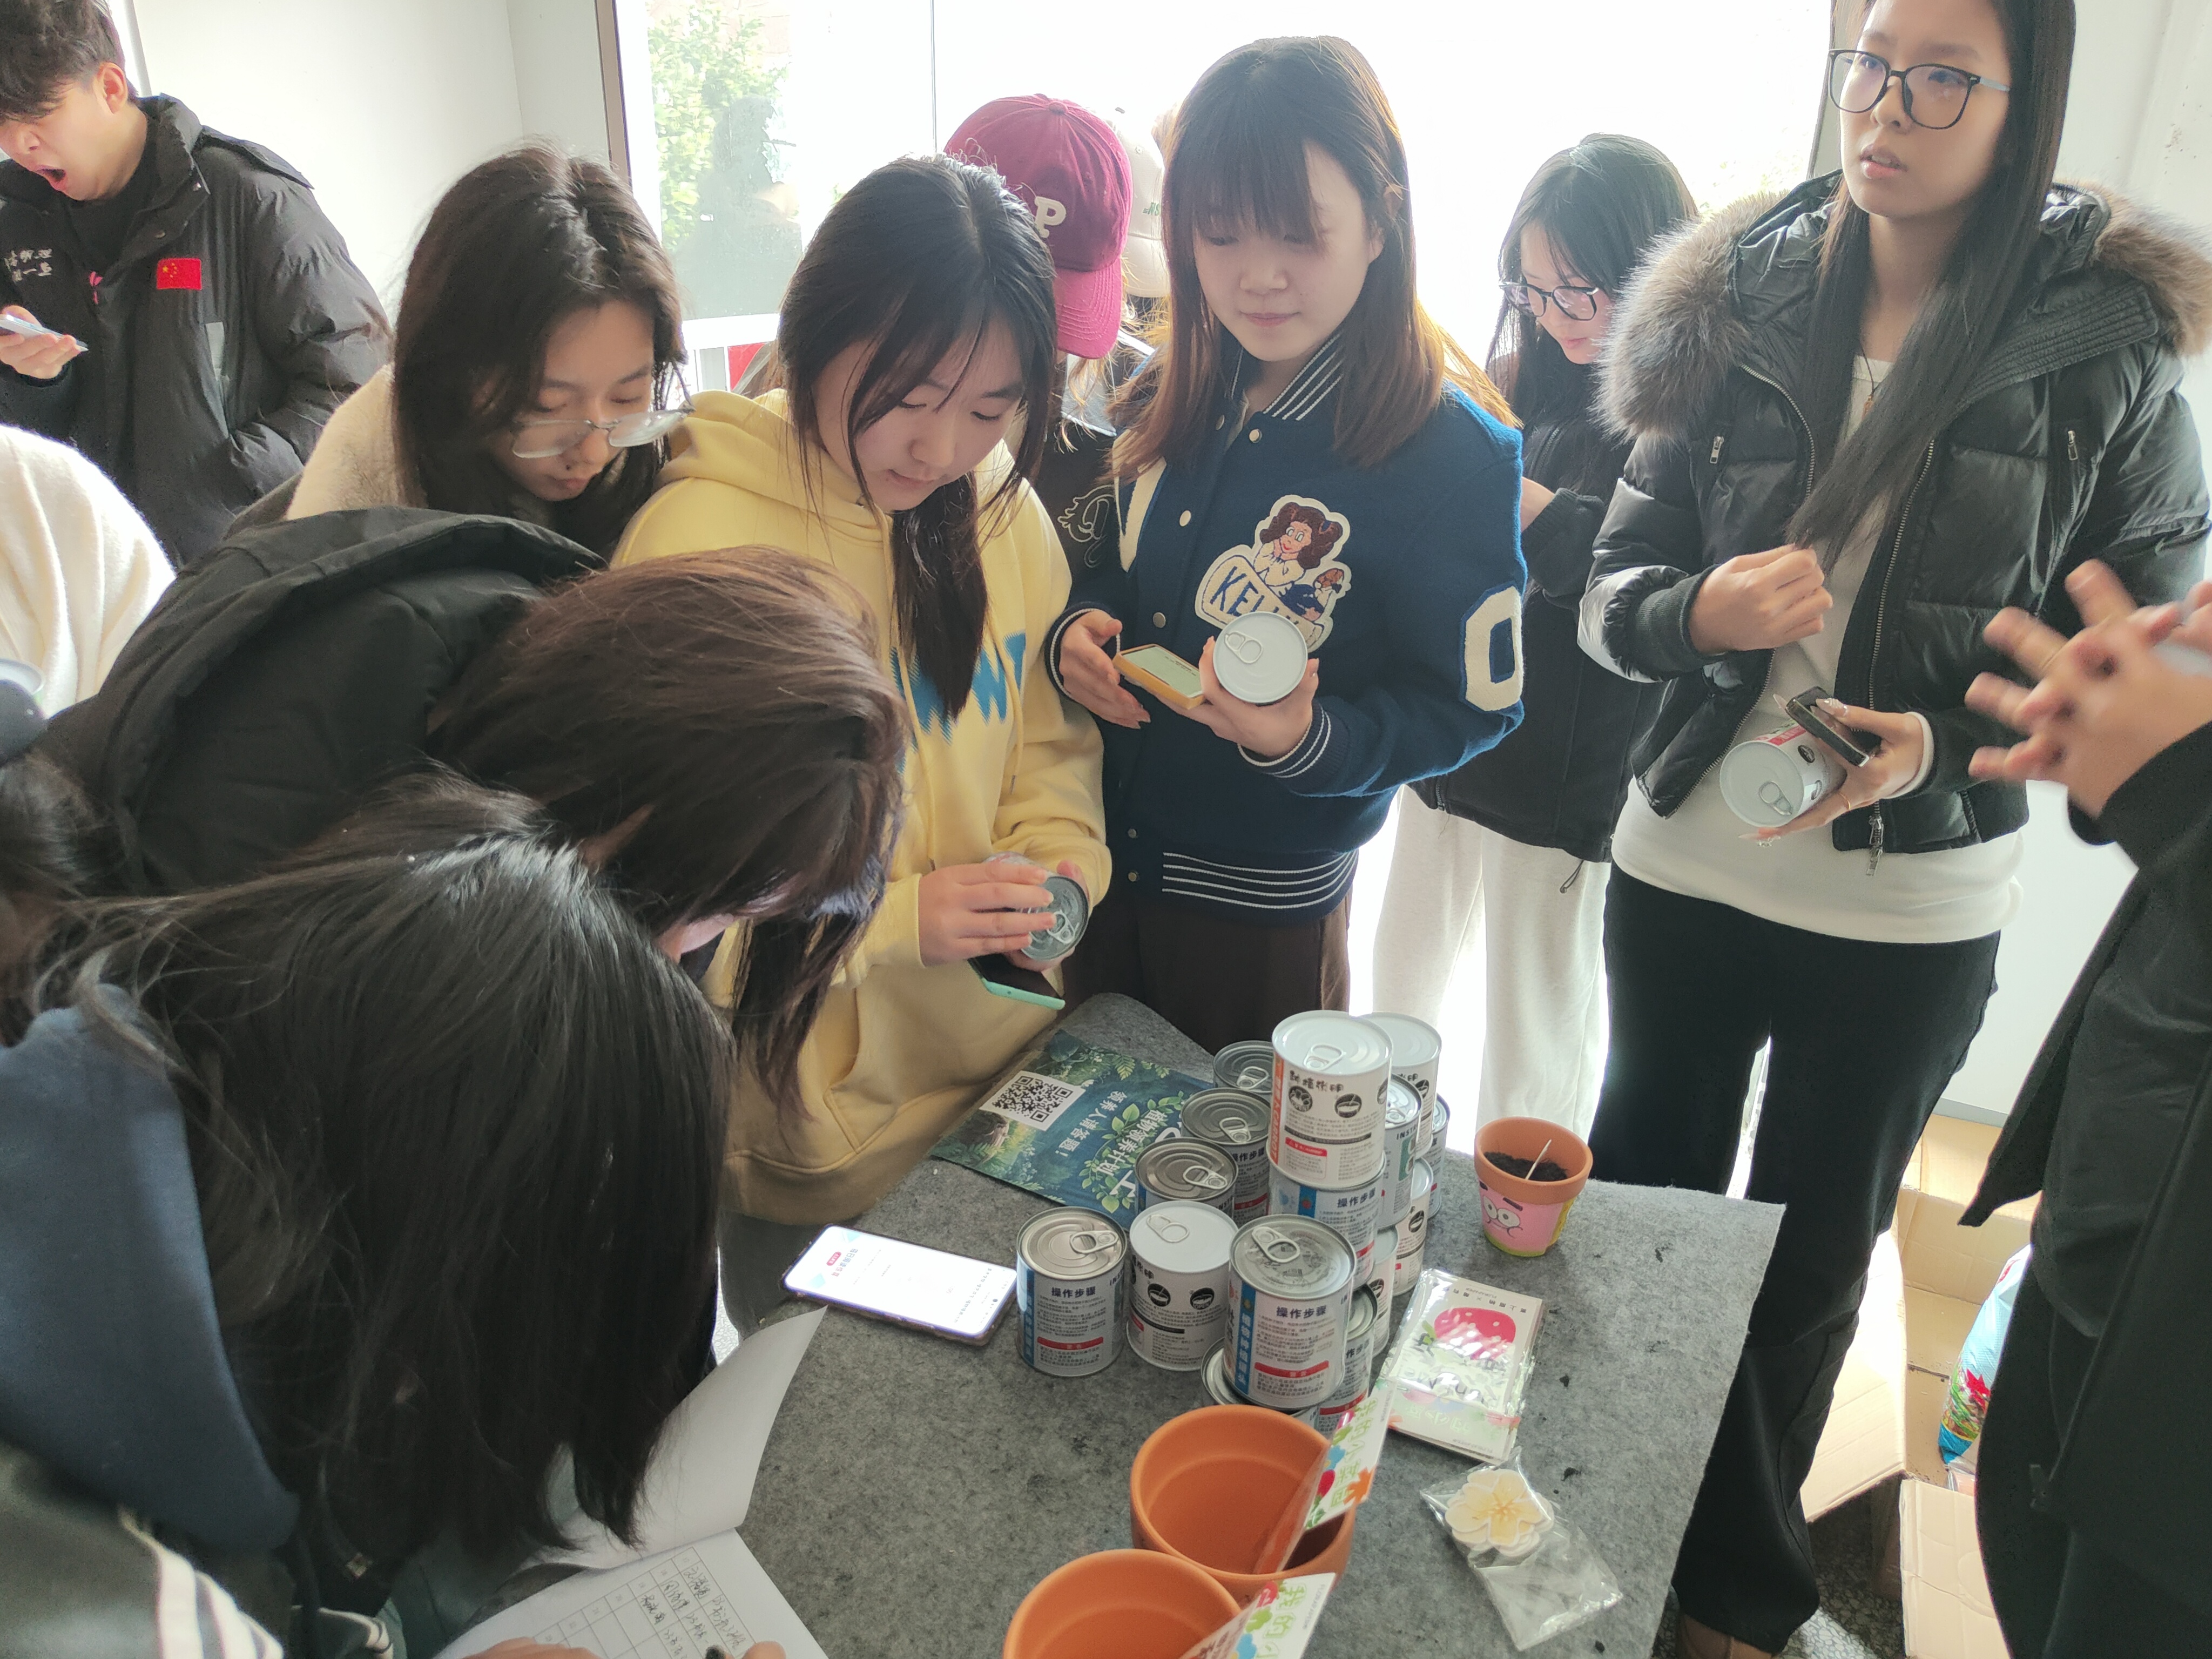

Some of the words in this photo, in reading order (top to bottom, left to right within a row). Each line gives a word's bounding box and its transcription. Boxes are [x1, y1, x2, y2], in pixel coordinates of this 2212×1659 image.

[1210, 566, 1298, 624] KEL
[1095, 1109, 1169, 1176] 植物领养计划
[1051, 1286, 1096, 1299] 操作步骤
[1276, 1305, 1326, 1319] 操作步骤
